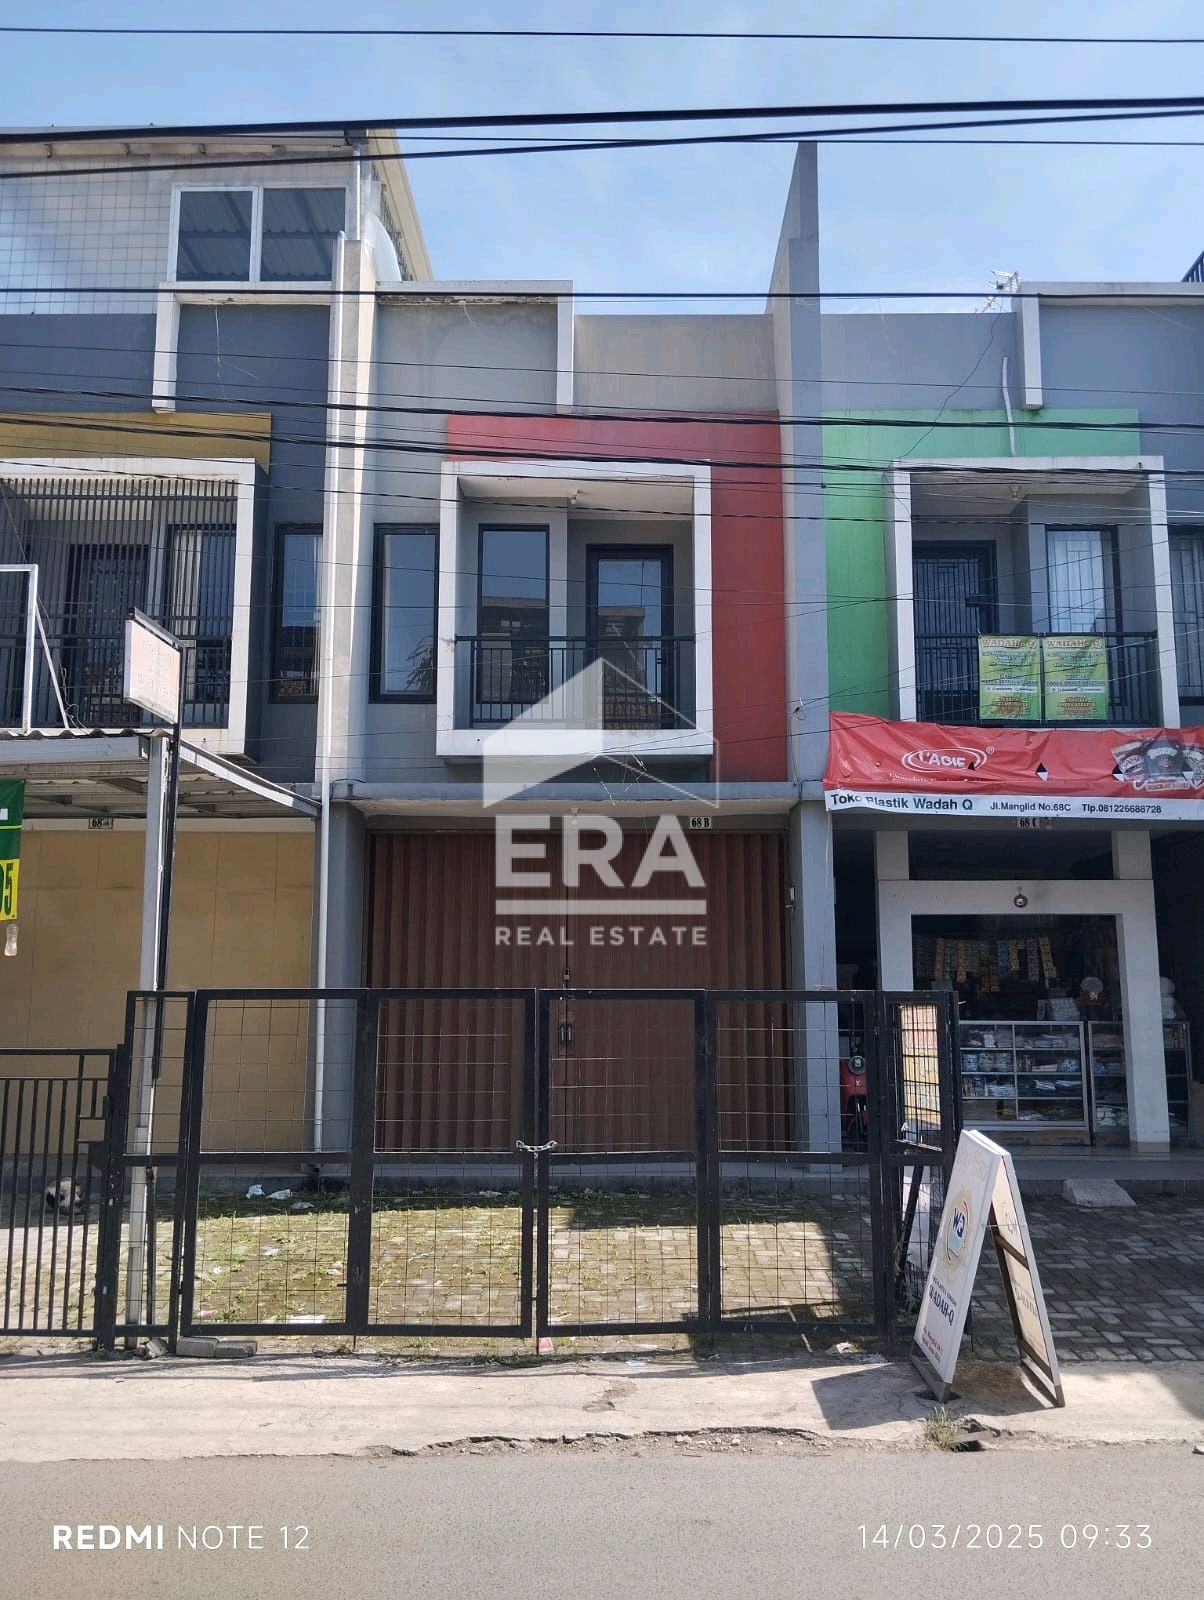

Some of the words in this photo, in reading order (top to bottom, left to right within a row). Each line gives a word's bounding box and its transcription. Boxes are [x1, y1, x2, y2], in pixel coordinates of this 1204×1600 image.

[913, 798, 958, 810] Wadah
[962, 799, 973, 811] Q
[691, 817, 702, 828] 68
[703, 818, 710, 827] B
